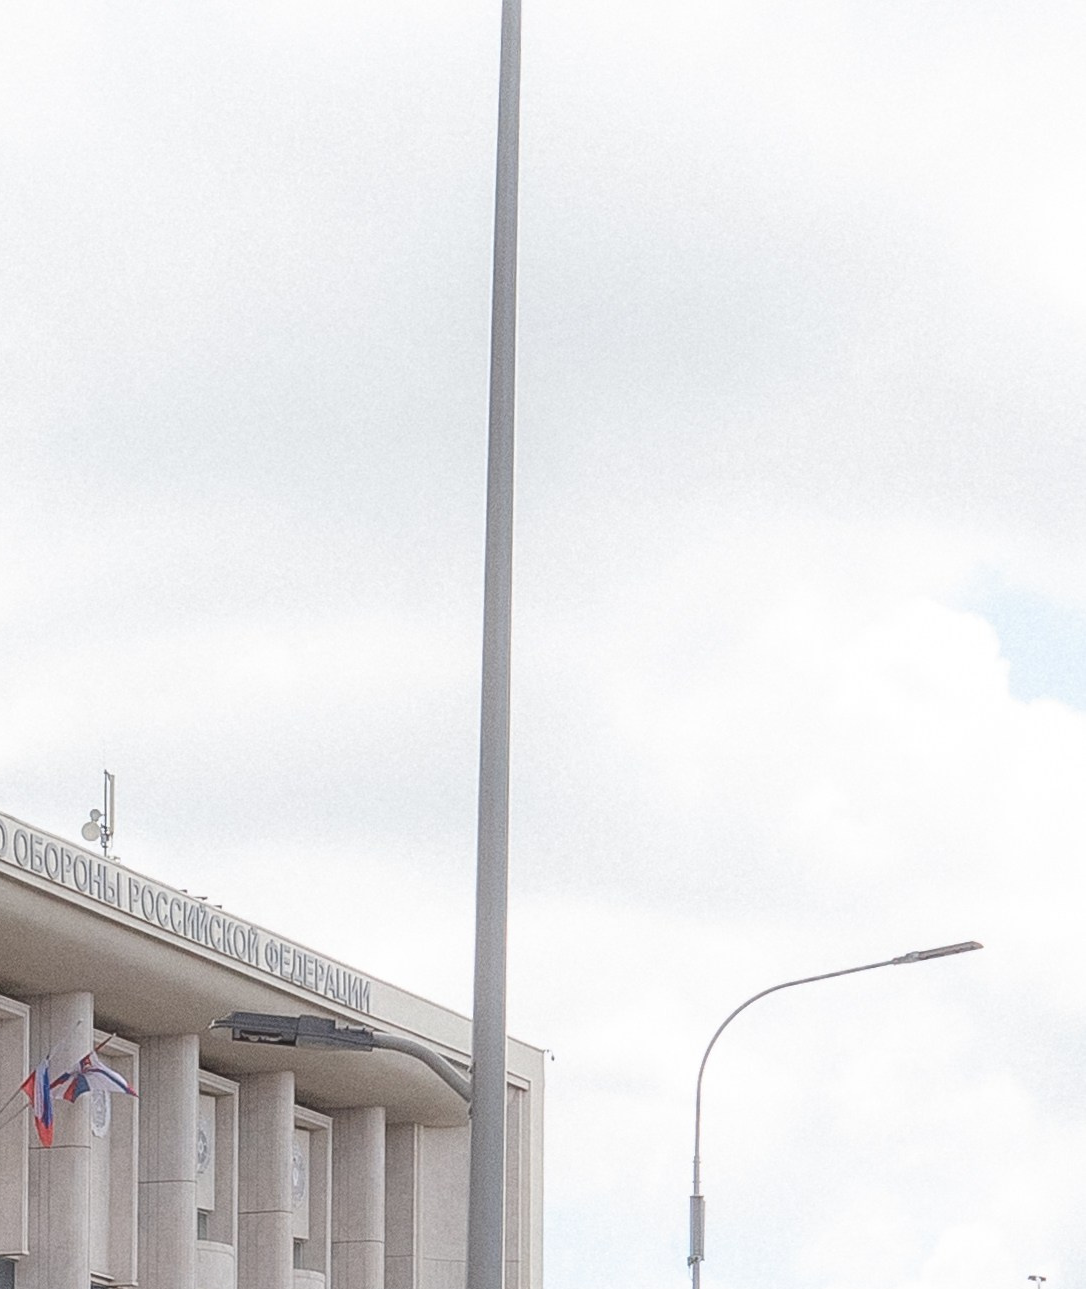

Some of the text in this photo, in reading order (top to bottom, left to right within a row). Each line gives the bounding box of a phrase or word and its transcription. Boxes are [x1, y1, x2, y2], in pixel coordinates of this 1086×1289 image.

[14, 828, 121, 908] ОБОРОНЫ
[128, 876, 259, 967] РОССИЙСКОЙ
[264, 938, 371, 1014] ФЕДЕРАЦИИ
